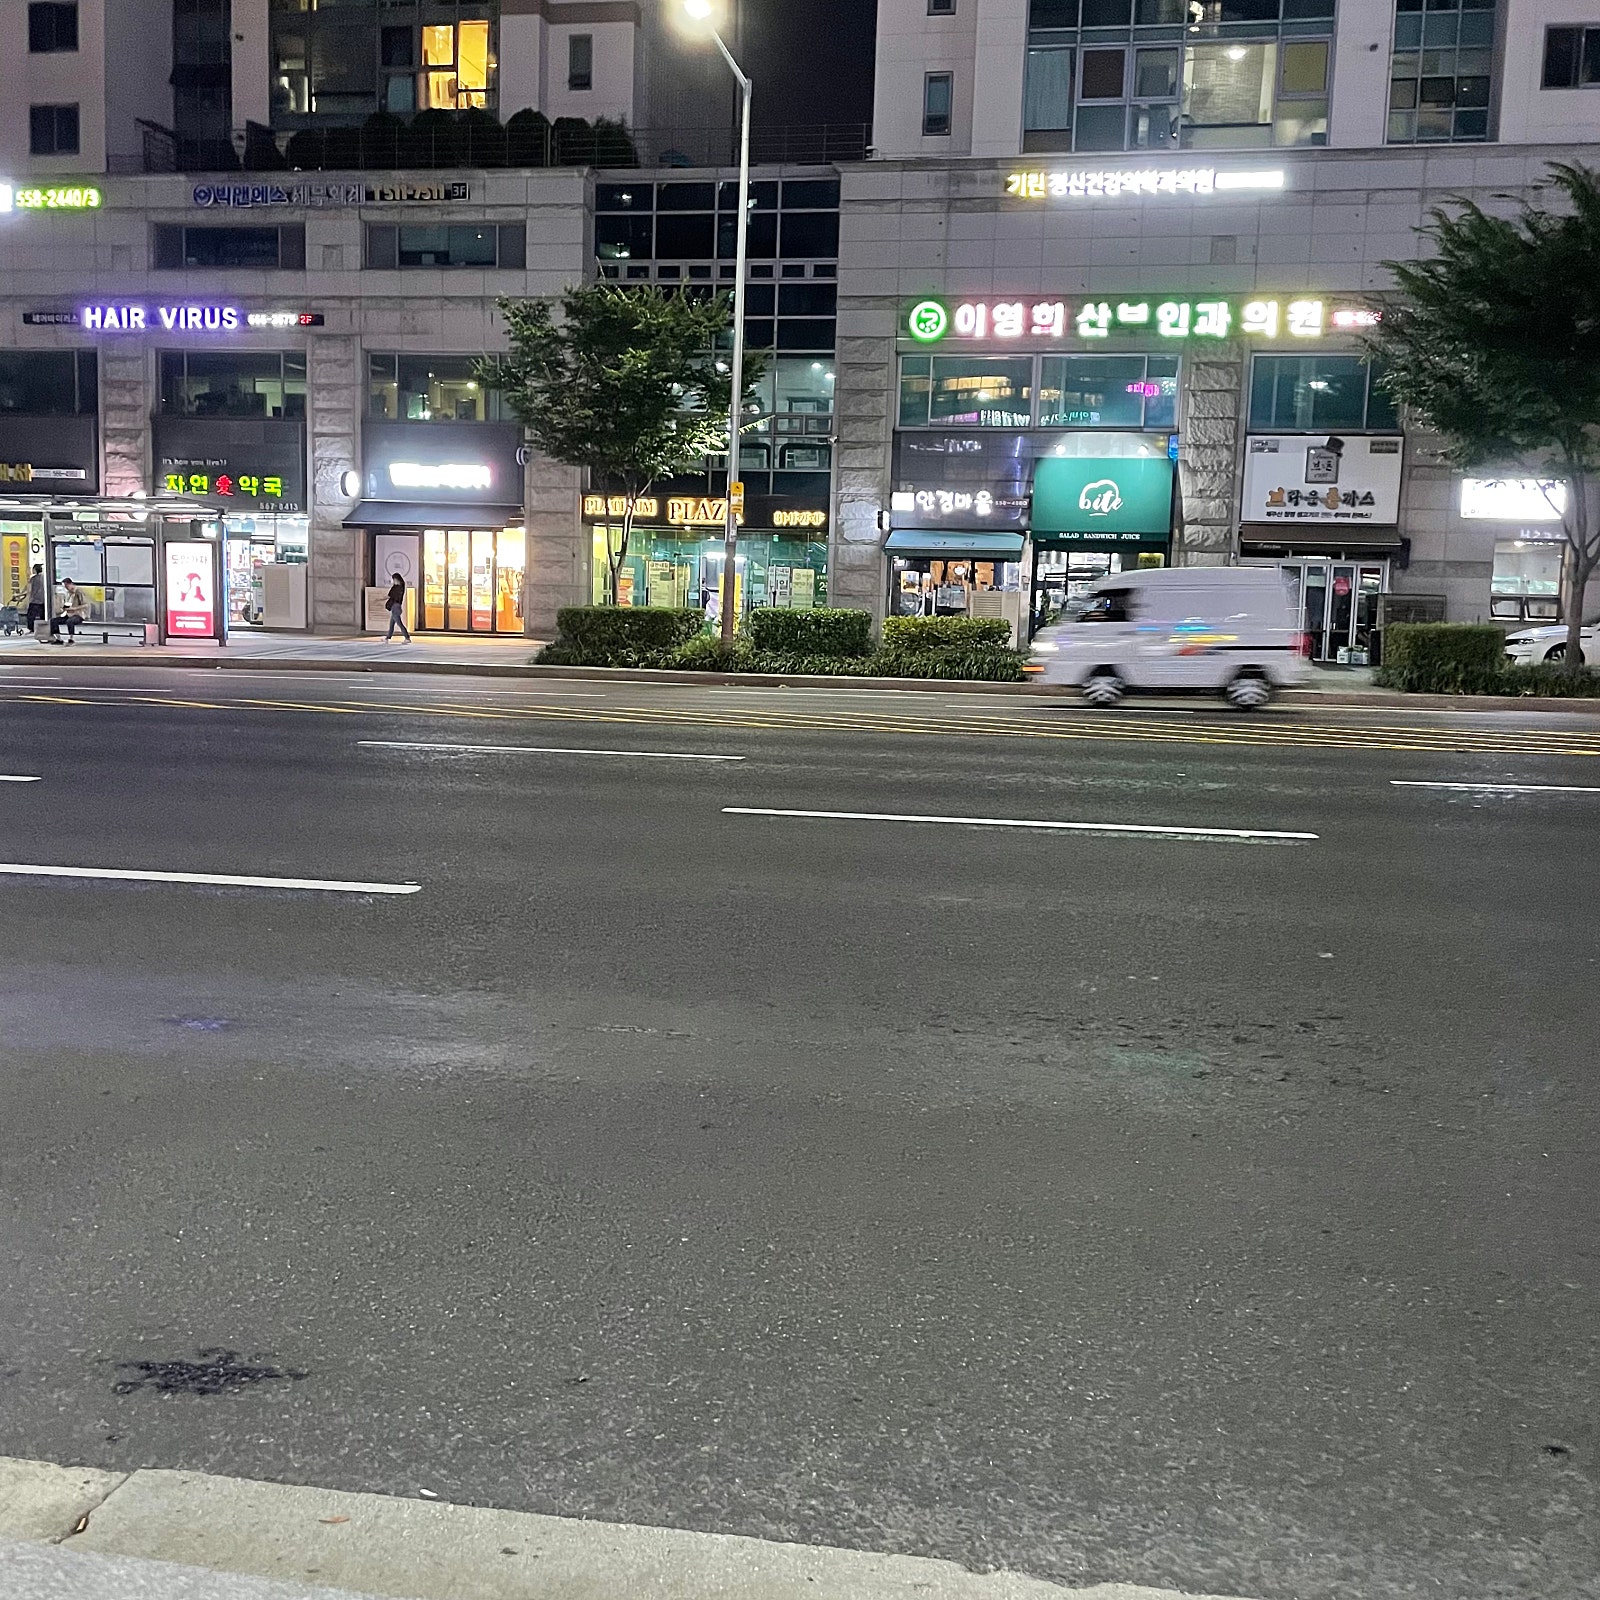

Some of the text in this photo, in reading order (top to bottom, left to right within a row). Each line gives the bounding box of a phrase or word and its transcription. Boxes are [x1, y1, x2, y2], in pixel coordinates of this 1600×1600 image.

[452, 185, 465, 197] 3F
[84, 306, 146, 329] HAIR
[159, 306, 238, 329] VIRUS
[300, 315, 313, 324] 2F
[957, 302, 1065, 337] 이영희
[1242, 301, 1324, 338] 의원
[585, 499, 653, 513] PLATIUM
[914, 491, 992, 516] 안경마을
[1078, 479, 1123, 513] bite
